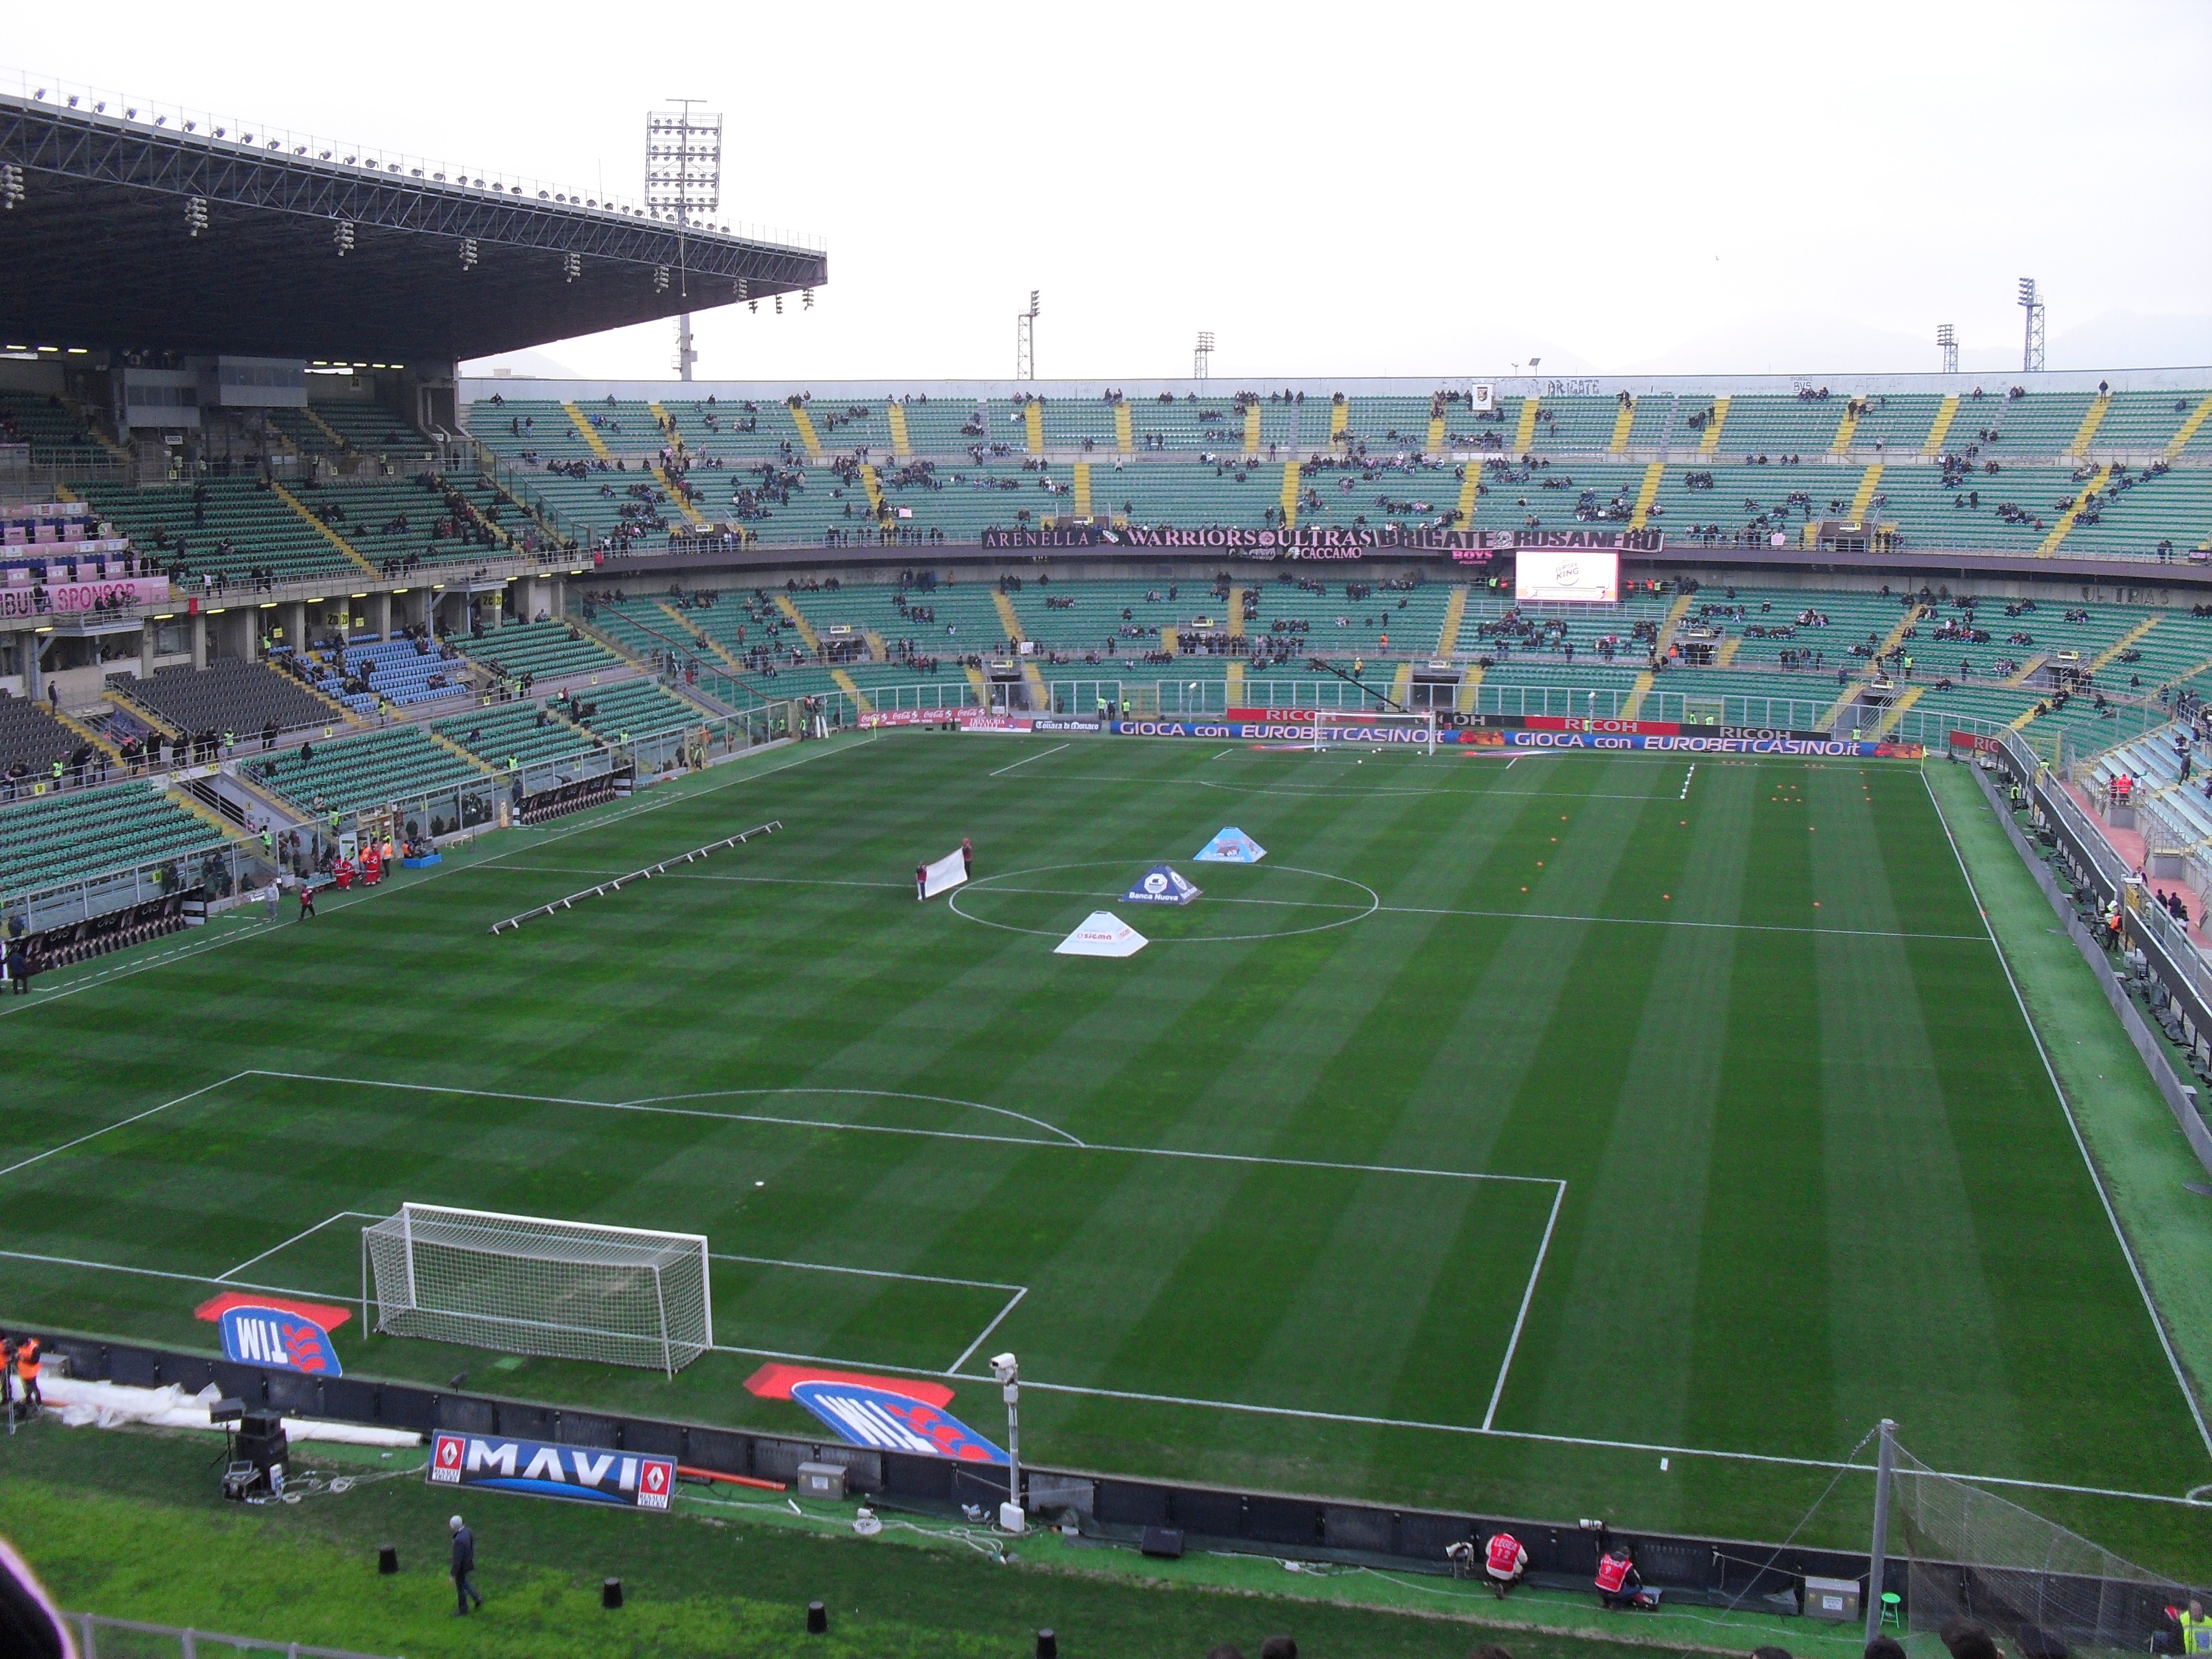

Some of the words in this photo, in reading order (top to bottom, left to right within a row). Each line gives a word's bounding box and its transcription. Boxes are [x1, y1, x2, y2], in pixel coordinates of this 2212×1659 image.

[986, 531, 1089, 547] ARENELLA
[1126, 529, 1257, 546] WARRIORS
[1278, 529, 1372, 546] ULTRAS
[1379, 529, 1495, 549] BRIGATE
[1301, 547, 1362, 559] CACCAMO
[1452, 550, 1493, 560] BOYS
[1556, 567, 1580, 580] KING
[1120, 722, 1186, 737] GIOCA
[1195, 726, 1230, 738] con
[1241, 724, 1446, 743] EUROBETCASINOt
[1564, 718, 1637, 732] RICOH
[1719, 726, 1791, 741] RICOH
[1515, 732, 1585, 749] GIOCA
[1594, 737, 1632, 749] con
[1644, 736, 1860, 756] EUROBETCASINO.it
[1129, 891, 1153, 900] Banca
[235, 1316, 289, 1364] TIM
[813, 1393, 939, 1454] TIM
[466, 1439, 638, 1491] MAVI
